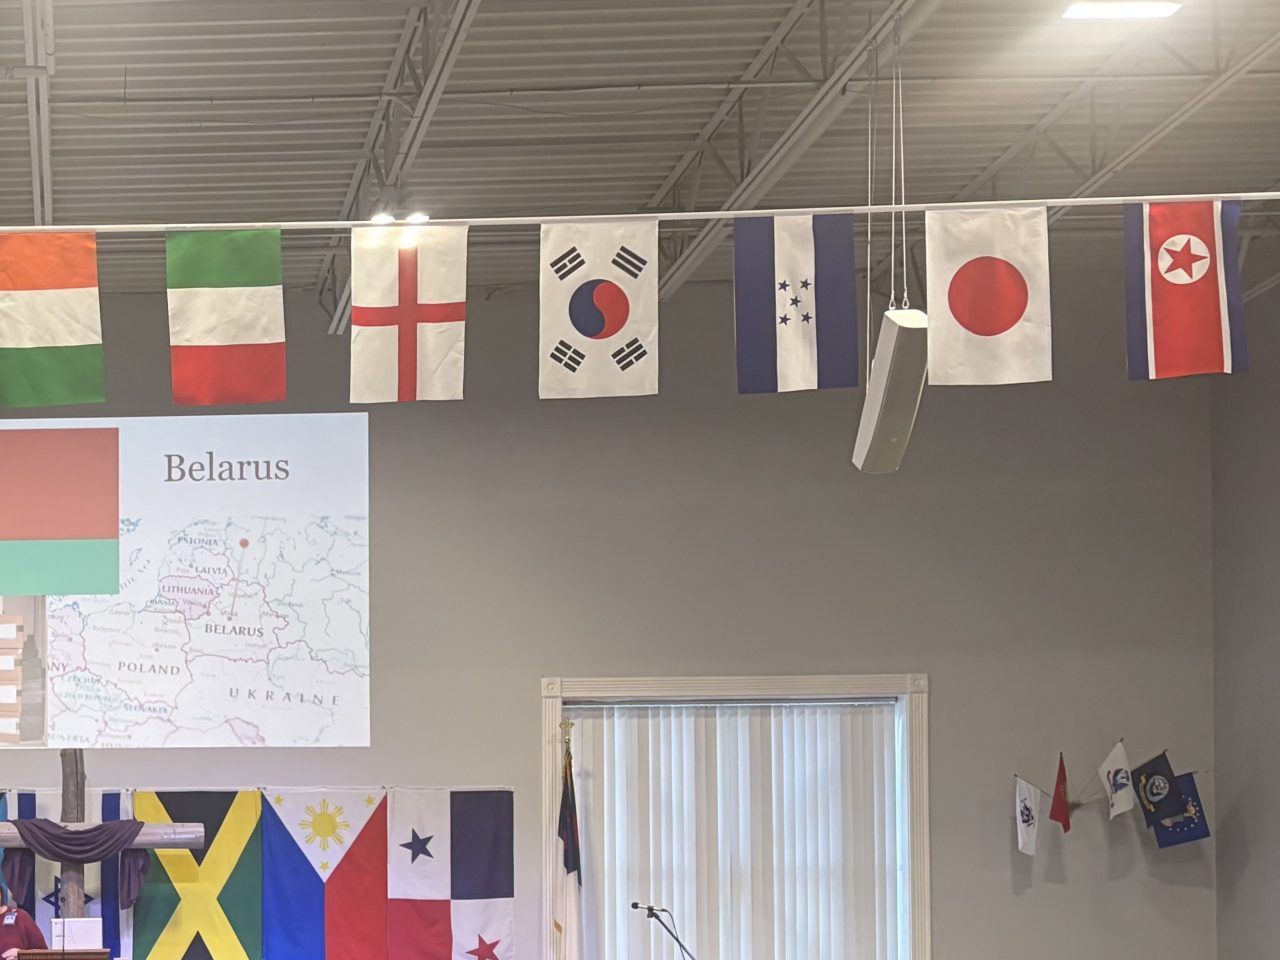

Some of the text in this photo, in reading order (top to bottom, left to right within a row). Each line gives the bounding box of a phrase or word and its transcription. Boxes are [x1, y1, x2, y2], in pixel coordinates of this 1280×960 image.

[164, 451, 289, 482] Belarus
[195, 567, 228, 576] LATVIA
[162, 584, 214, 596] LITHUANIA
[205, 623, 264, 638] BELARUS
[118, 661, 180, 676] POLAND
[229, 687, 340, 706] UKRAINE
